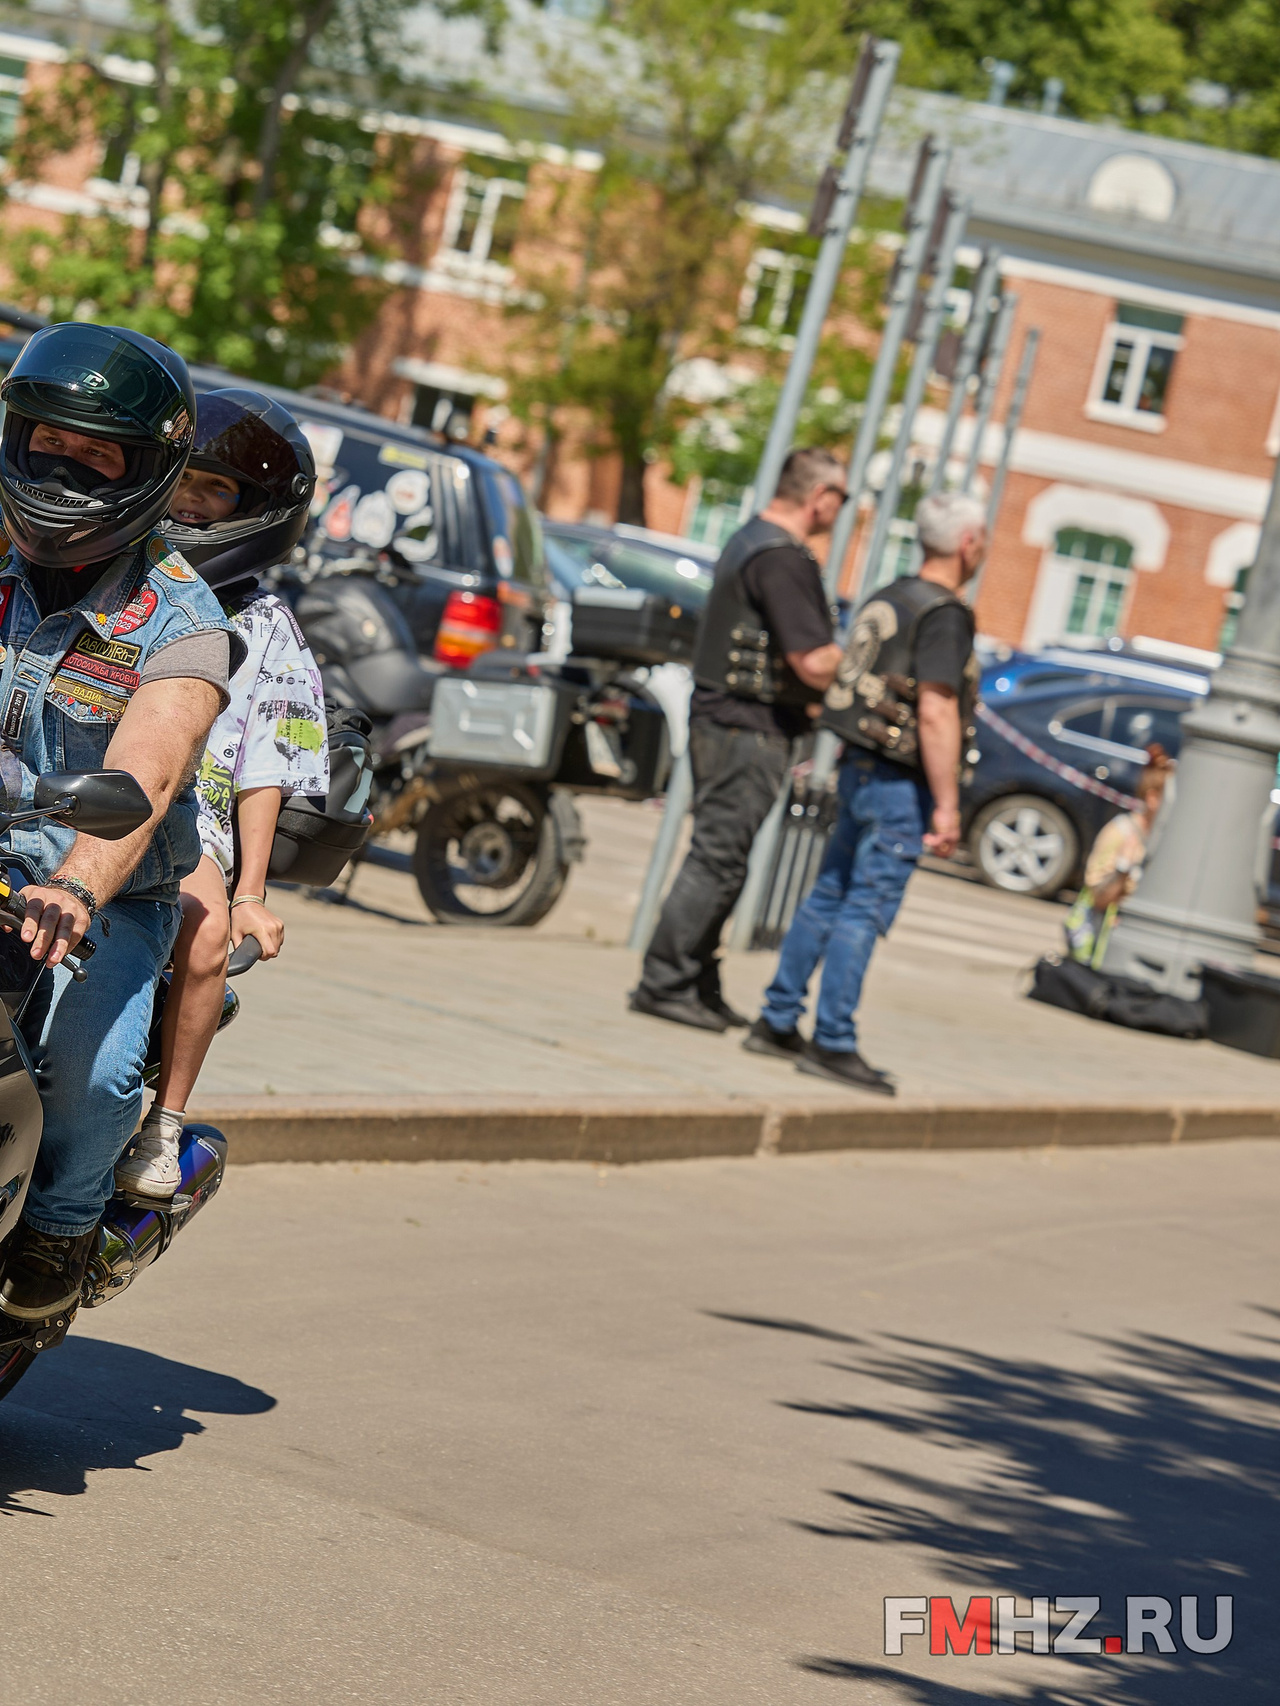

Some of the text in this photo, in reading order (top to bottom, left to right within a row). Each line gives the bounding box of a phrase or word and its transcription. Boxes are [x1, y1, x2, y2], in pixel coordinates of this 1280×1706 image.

[116, 619, 132, 630] 023
[109, 670, 137, 686] КРОВИ
[72, 686, 103, 702] ВАДИК
